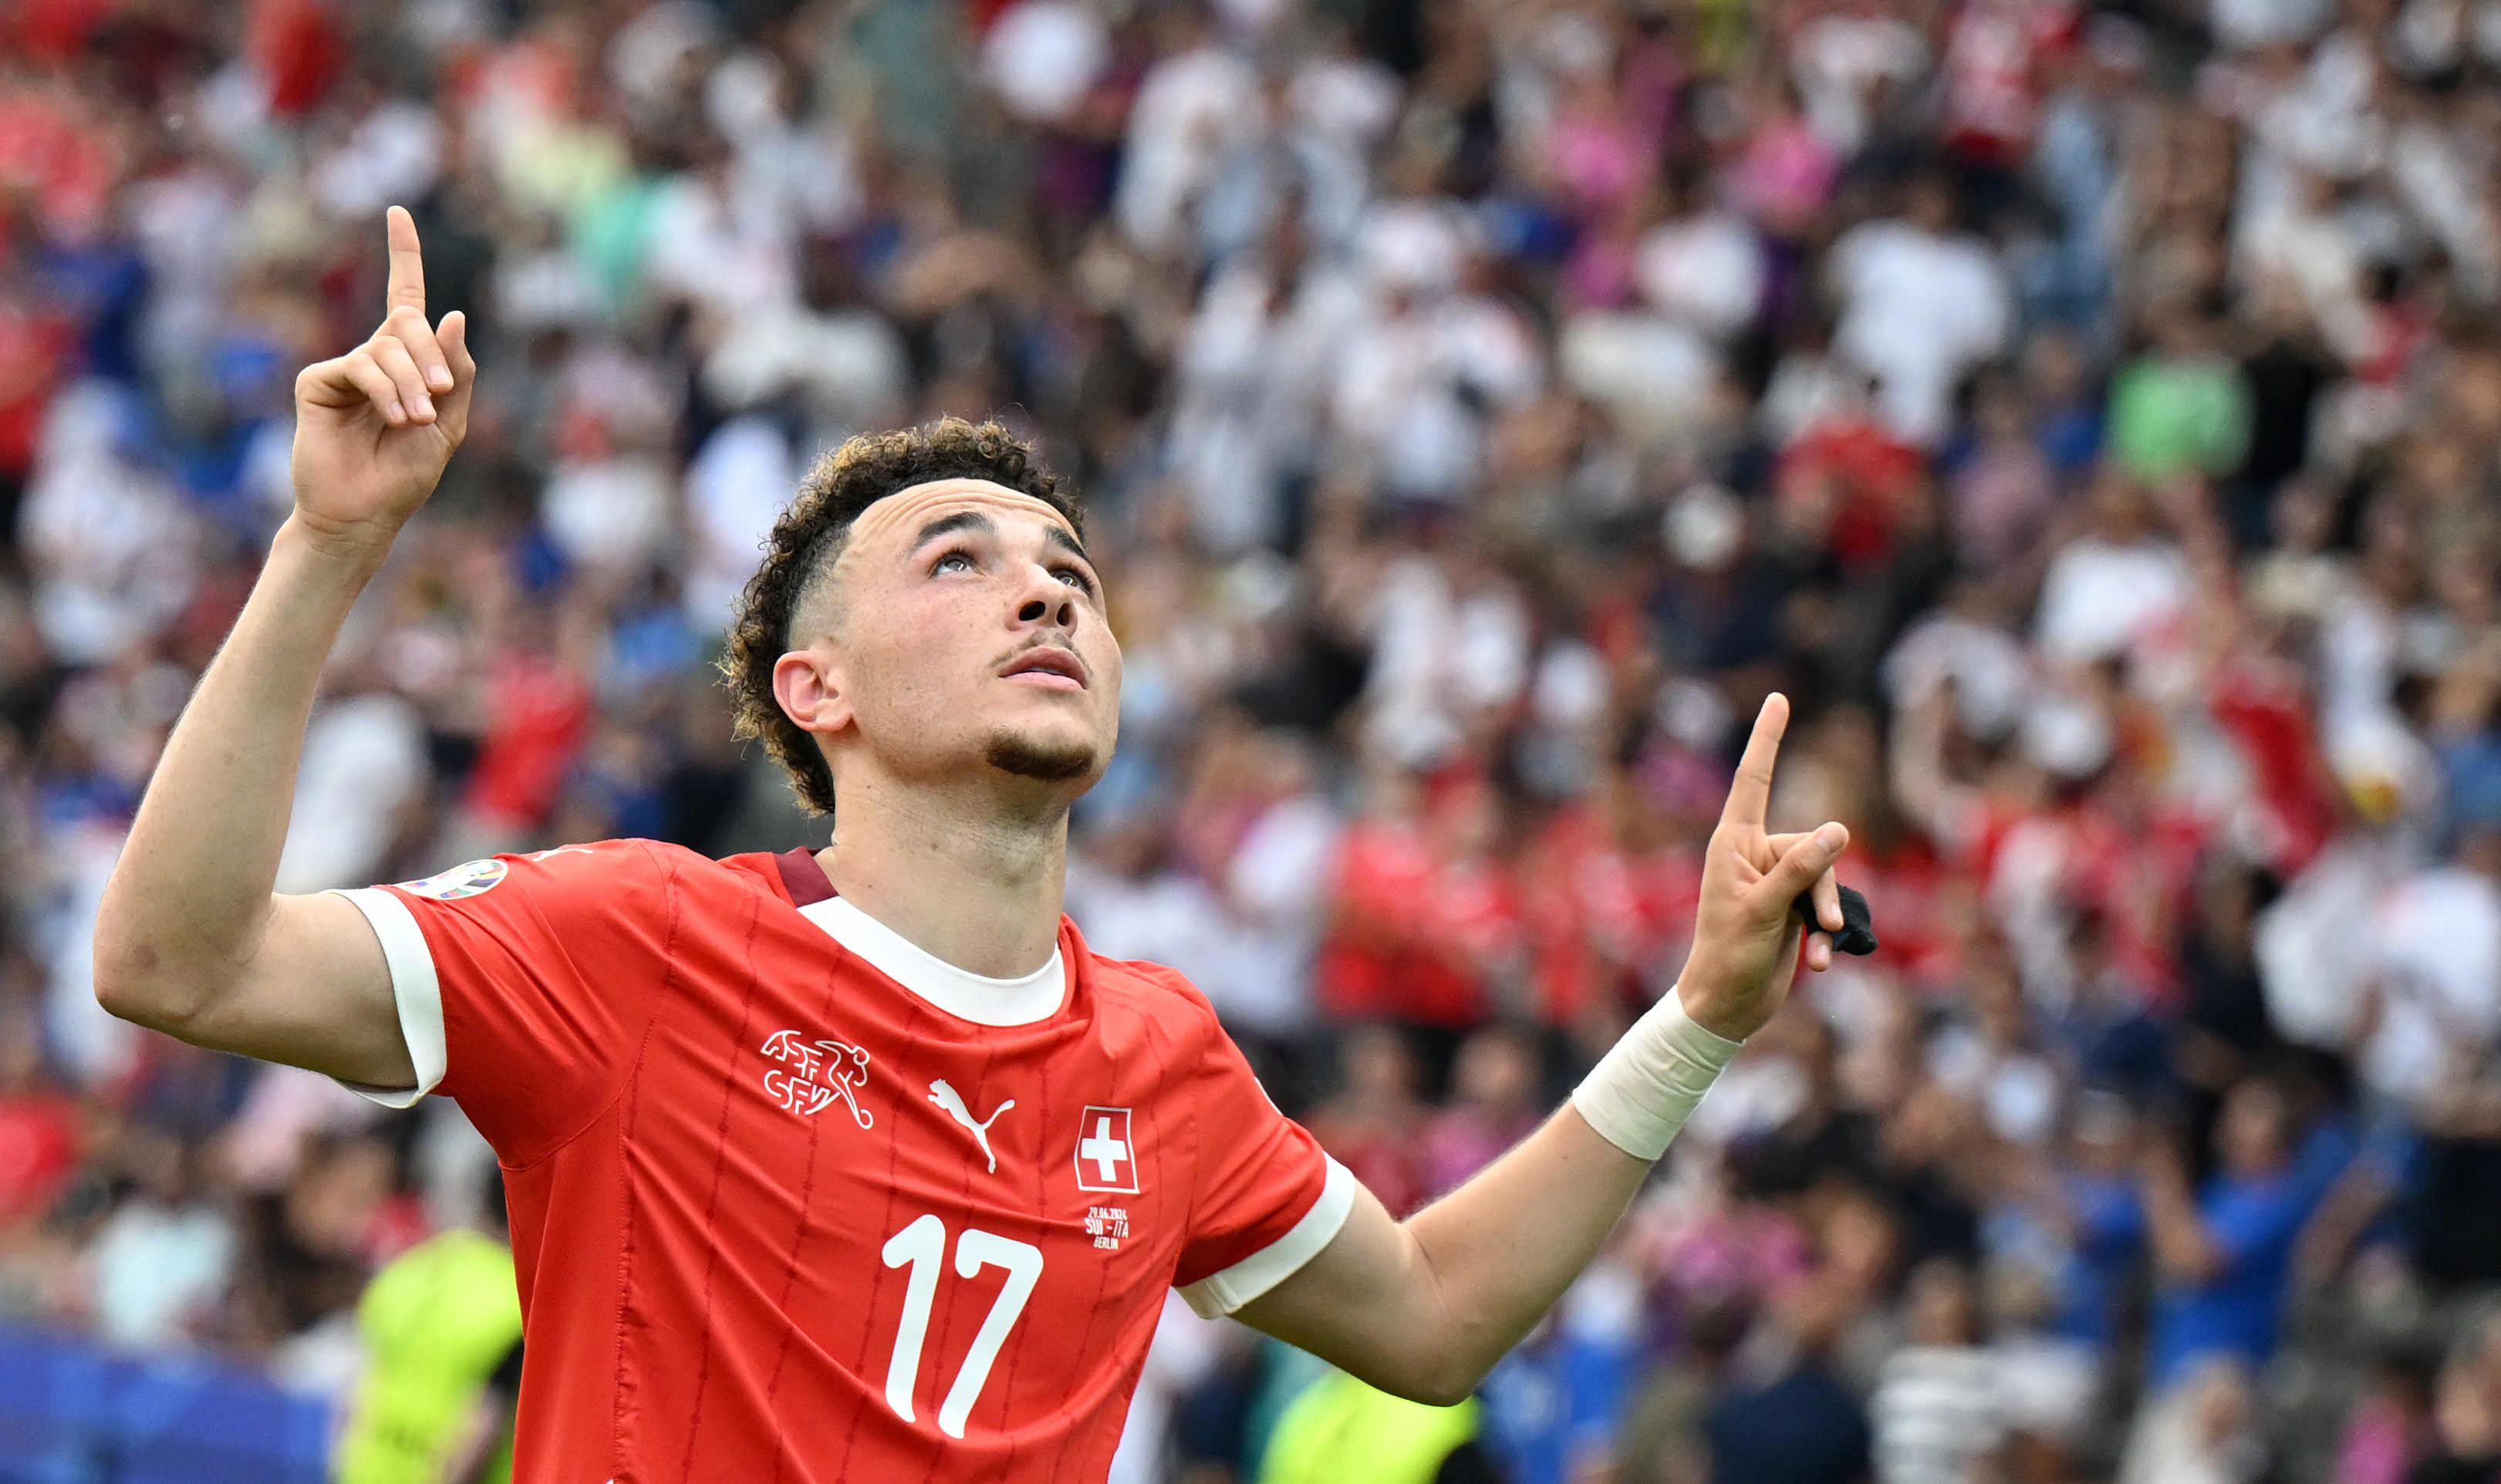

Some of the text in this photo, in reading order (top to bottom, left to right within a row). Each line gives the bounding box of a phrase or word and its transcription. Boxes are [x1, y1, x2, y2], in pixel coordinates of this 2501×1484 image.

[1084, 1217, 1104, 1236] SUI
[1112, 1220, 1129, 1239] ITA
[1093, 1236, 1119, 1250] BERLIN
[882, 1214, 1044, 1439] 17
